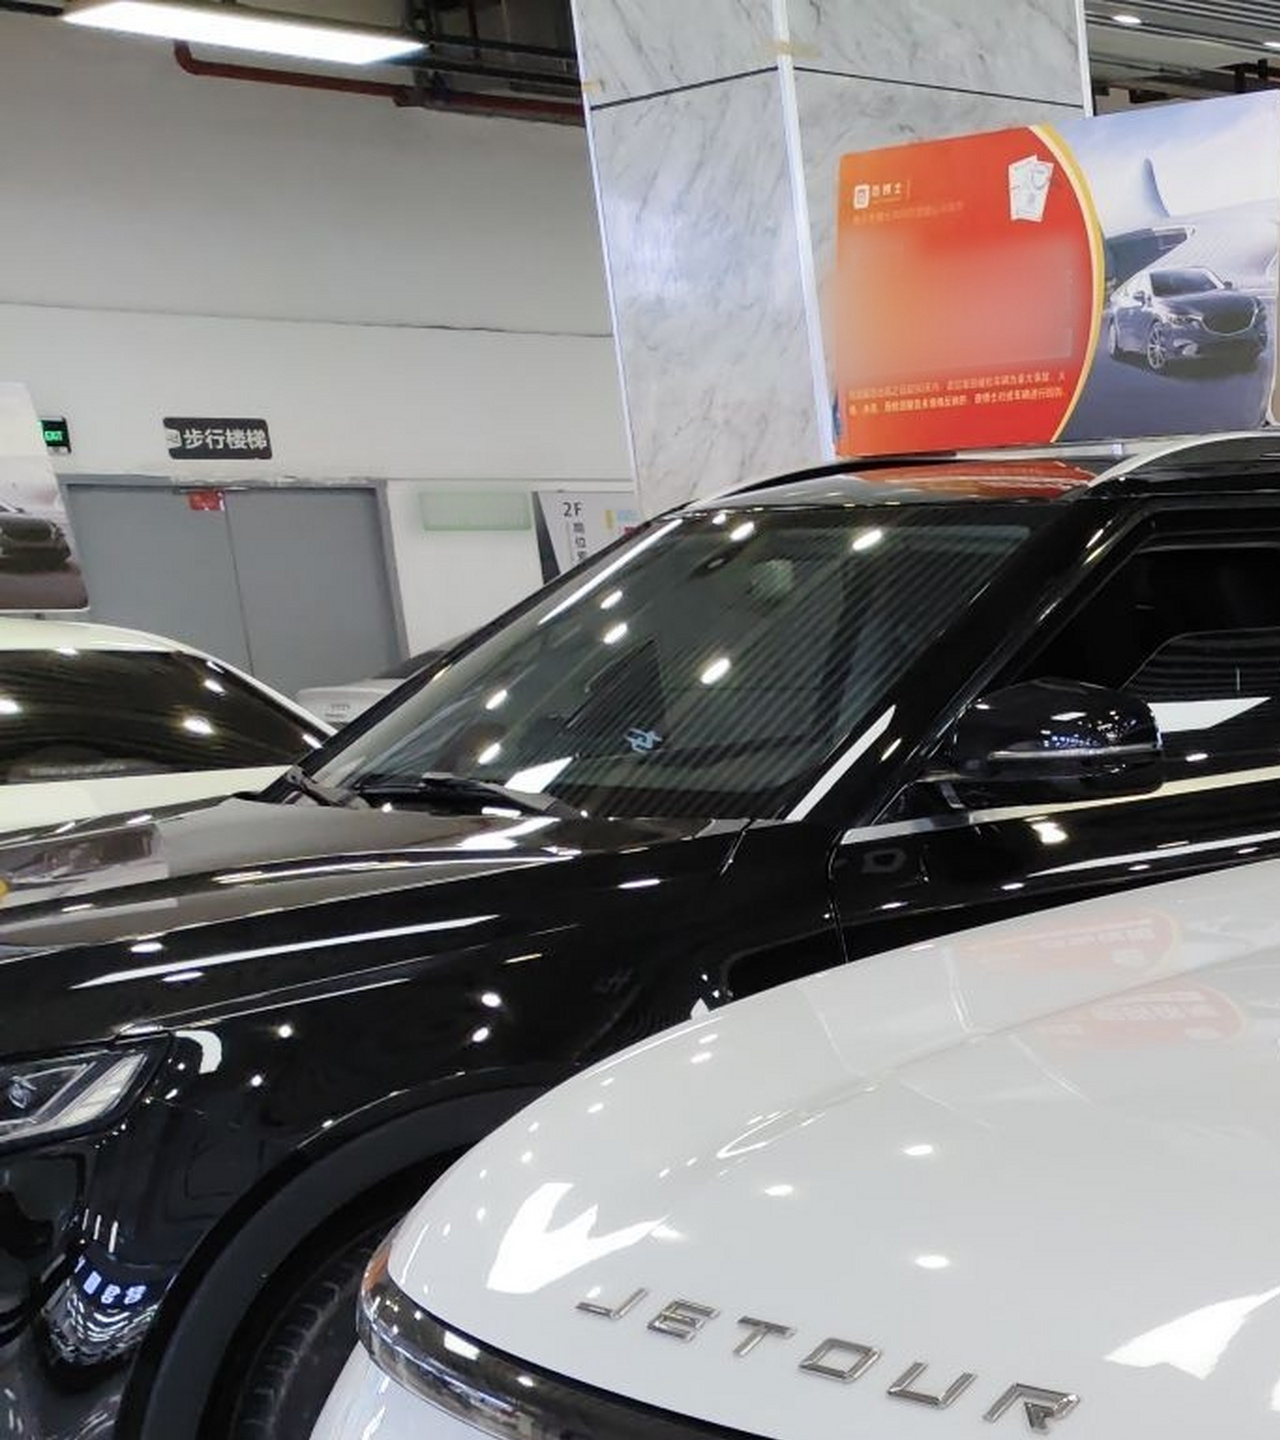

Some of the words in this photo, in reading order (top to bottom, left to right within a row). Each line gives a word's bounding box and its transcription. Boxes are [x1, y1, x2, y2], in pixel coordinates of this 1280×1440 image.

[183, 428, 268, 451] 步行楼梯
[563, 502, 582, 517] 2F
[575, 1287, 1081, 1434] JETOUR
